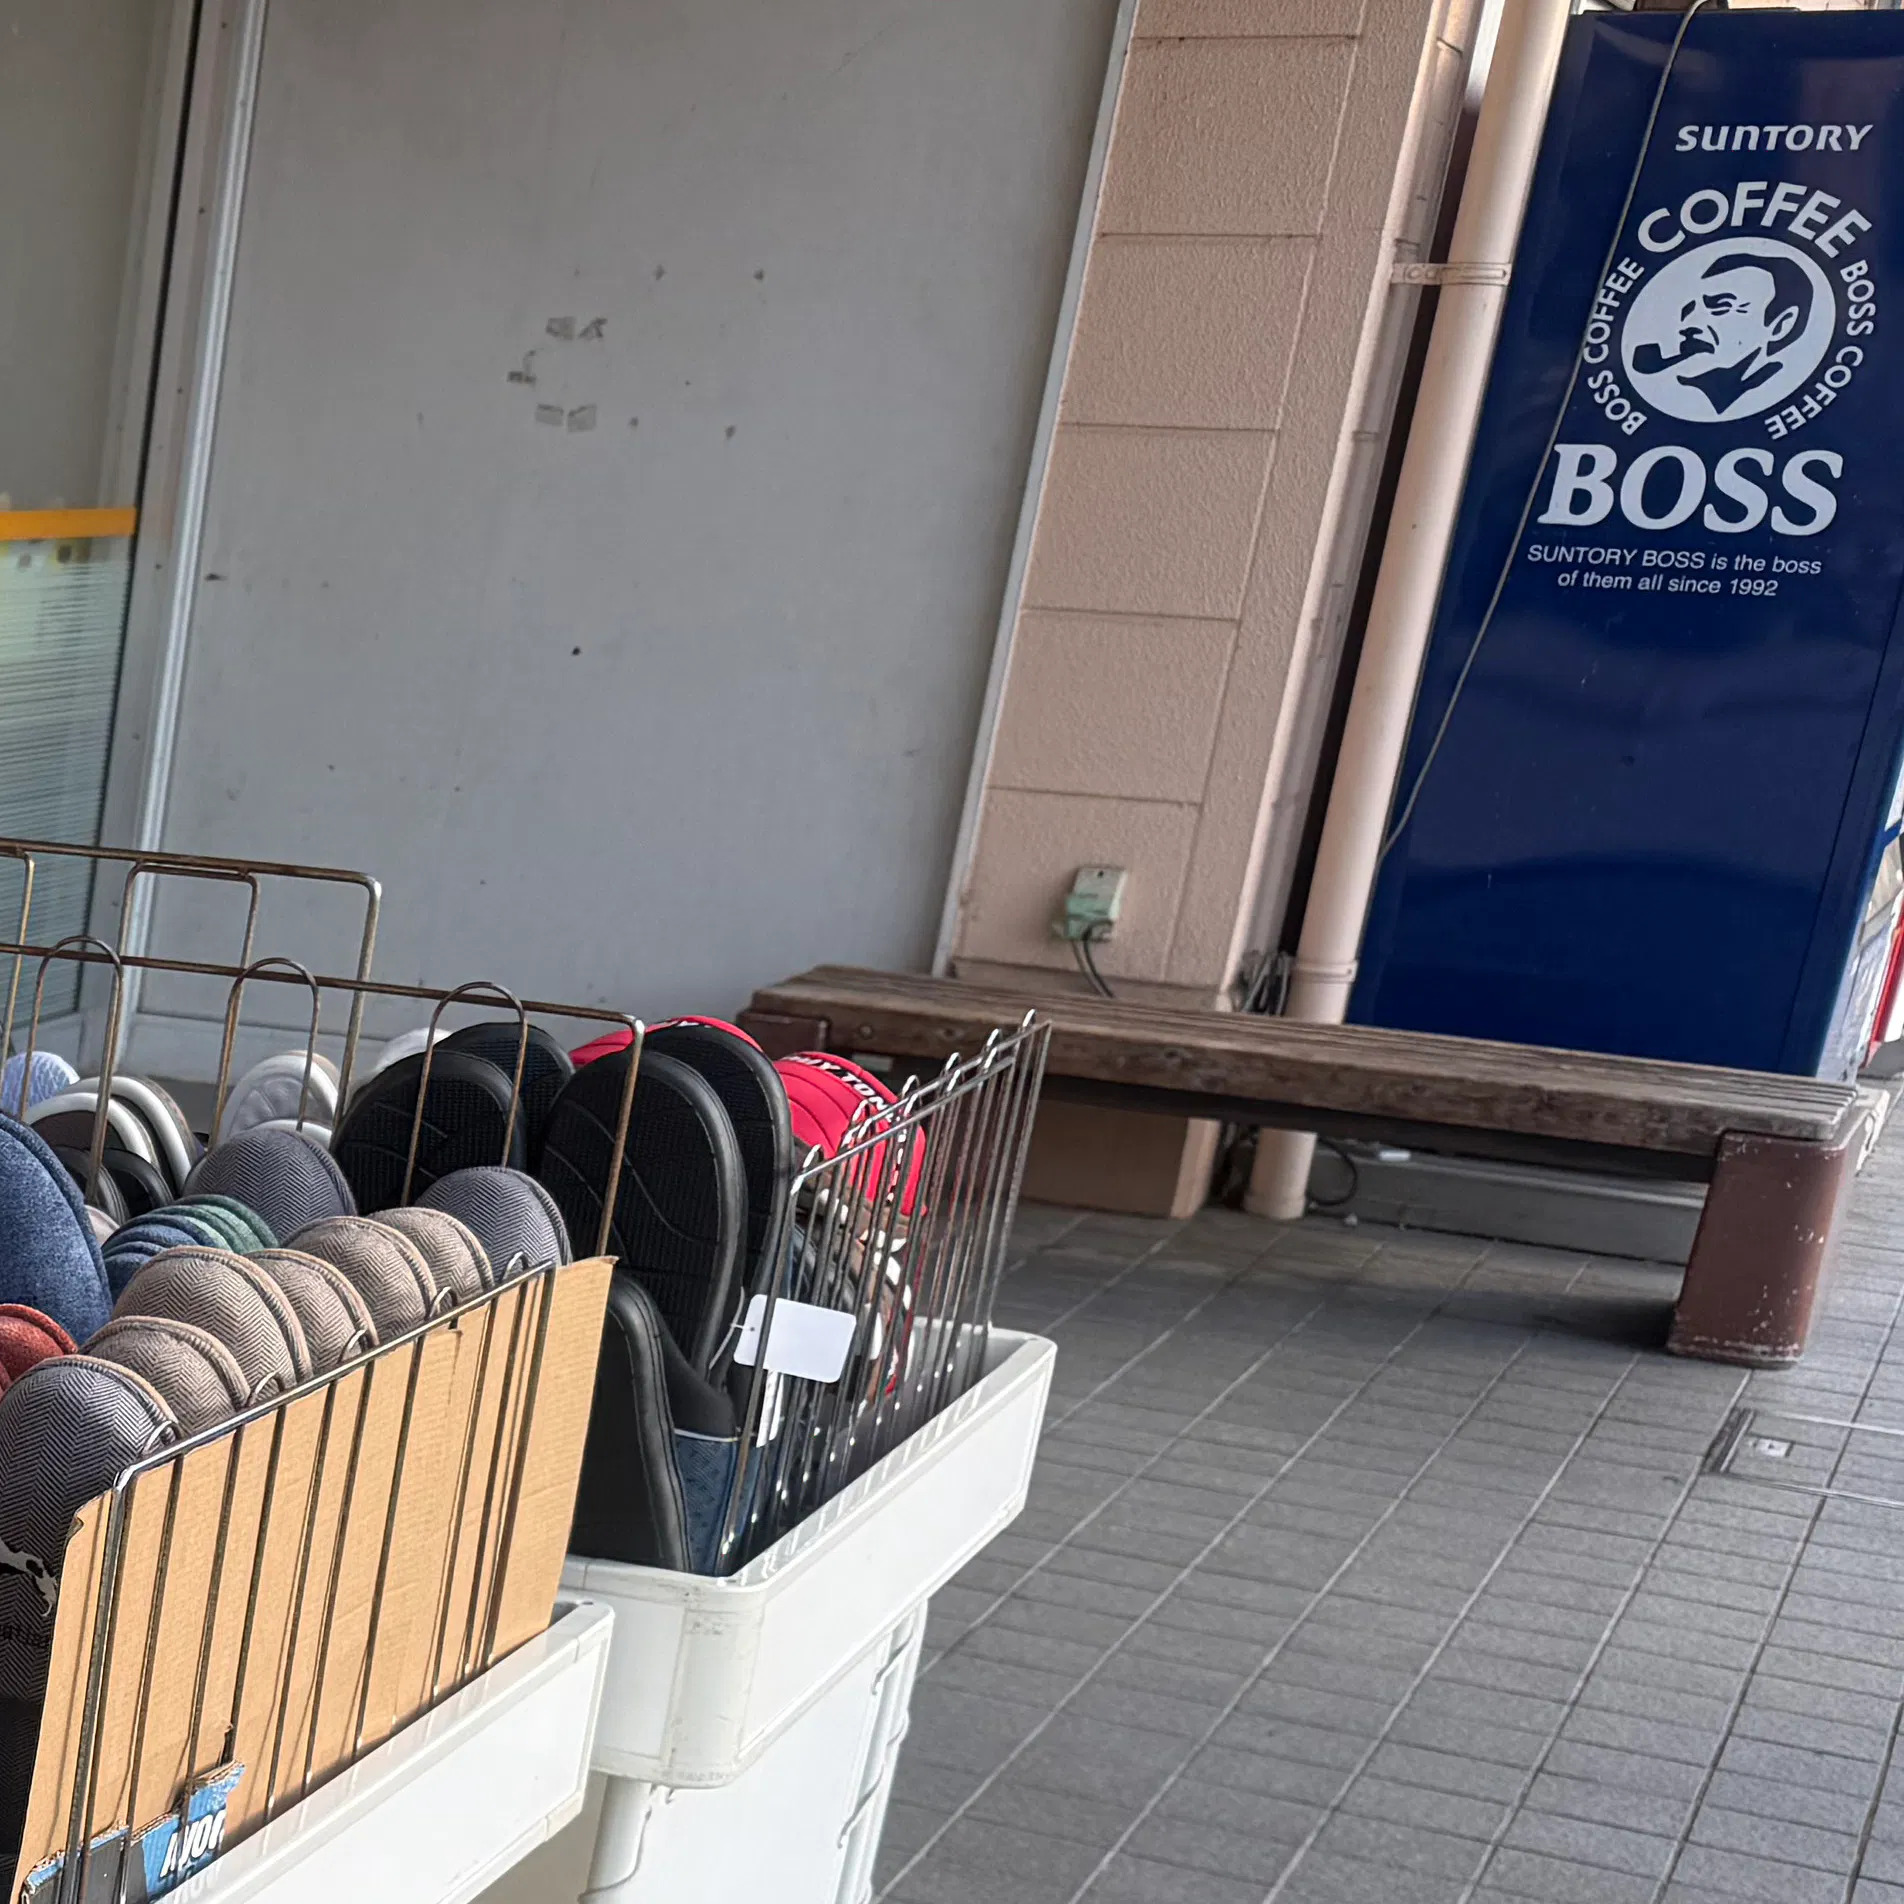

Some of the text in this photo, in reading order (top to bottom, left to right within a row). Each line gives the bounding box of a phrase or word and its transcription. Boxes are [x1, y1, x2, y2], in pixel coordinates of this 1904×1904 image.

[1675, 123, 1873, 153] SUNTORY
[1637, 180, 1873, 259] COFFEE
[1582, 257, 1647, 436] BOSS COFFEE
[1764, 259, 1877, 440] BOSS COFFEE
[1537, 443, 1844, 536] BOSS
[1527, 544, 1822, 575] SUNTORY BOSS is the boss
[1557, 571, 1778, 596] of them all since 1992
